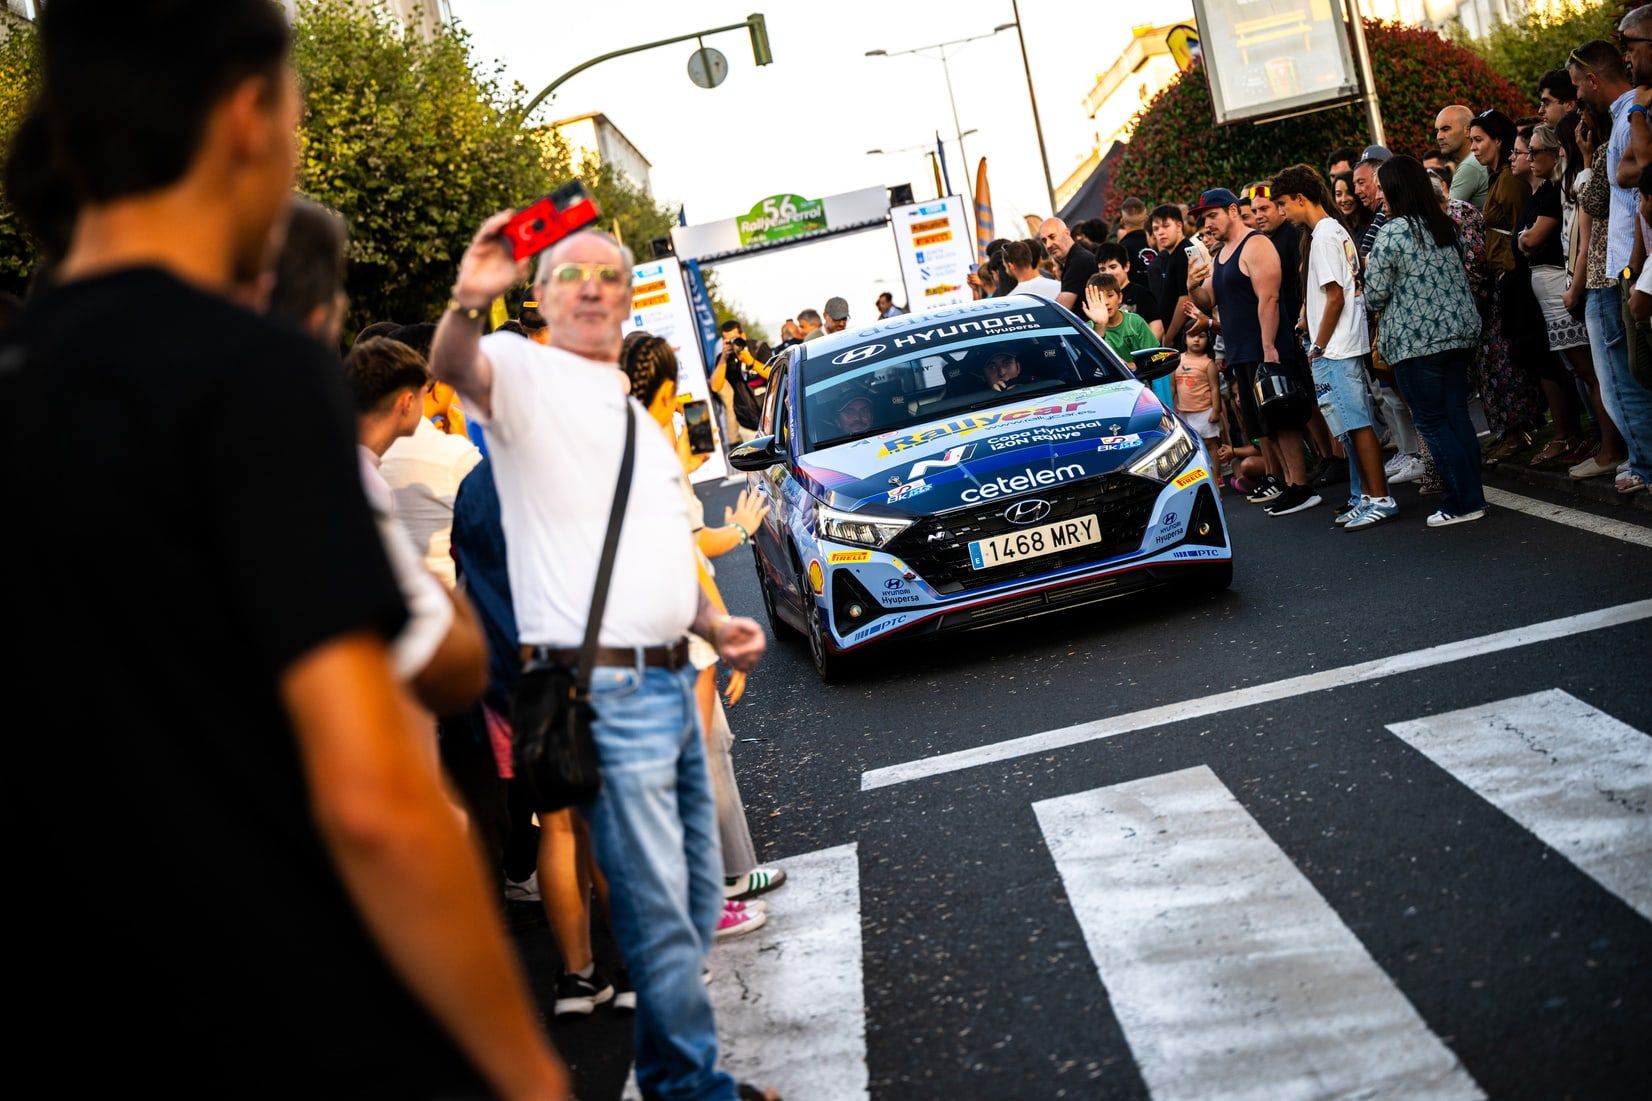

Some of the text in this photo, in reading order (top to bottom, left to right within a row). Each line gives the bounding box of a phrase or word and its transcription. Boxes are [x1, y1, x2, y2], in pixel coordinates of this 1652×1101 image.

[763, 195, 798, 227] 56
[894, 313, 1036, 348] HYUNDAI
[985, 323, 1041, 335] Hyupersa
[884, 401, 1087, 451] Rallycar
[987, 420, 1102, 444] Copa Hyundai
[1032, 430, 1081, 444] Rallye
[960, 464, 1086, 502] cetelem
[1176, 469, 1206, 487] PIRELLI
[1155, 528, 1184, 544] Hyupersa
[1160, 522, 1182, 534] HYUNDAI
[989, 531, 1045, 561] 1468
[1051, 519, 1093, 548] MRY
[832, 552, 868, 562] PIRELLI
[1199, 549, 1219, 557] PTC
[881, 595, 920, 605] Hyupersa
[881, 615, 907, 630] PTC
